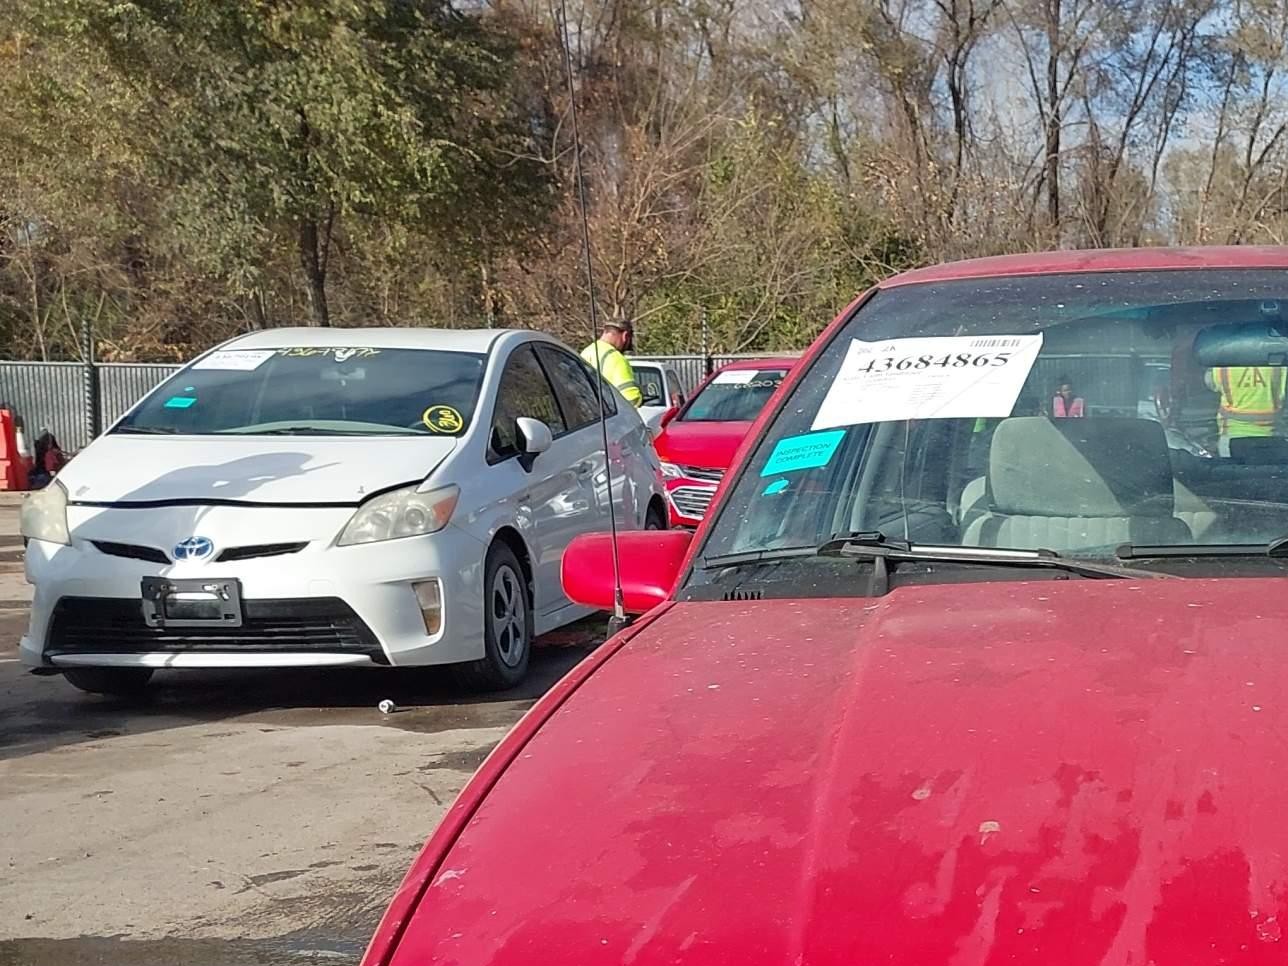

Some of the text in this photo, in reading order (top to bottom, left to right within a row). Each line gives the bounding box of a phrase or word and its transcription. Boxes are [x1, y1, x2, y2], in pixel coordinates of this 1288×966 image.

[858, 352, 1013, 374] 43684865
[776, 443, 832, 457] INSPECTION
[775, 451, 825, 464] COMPLETE
